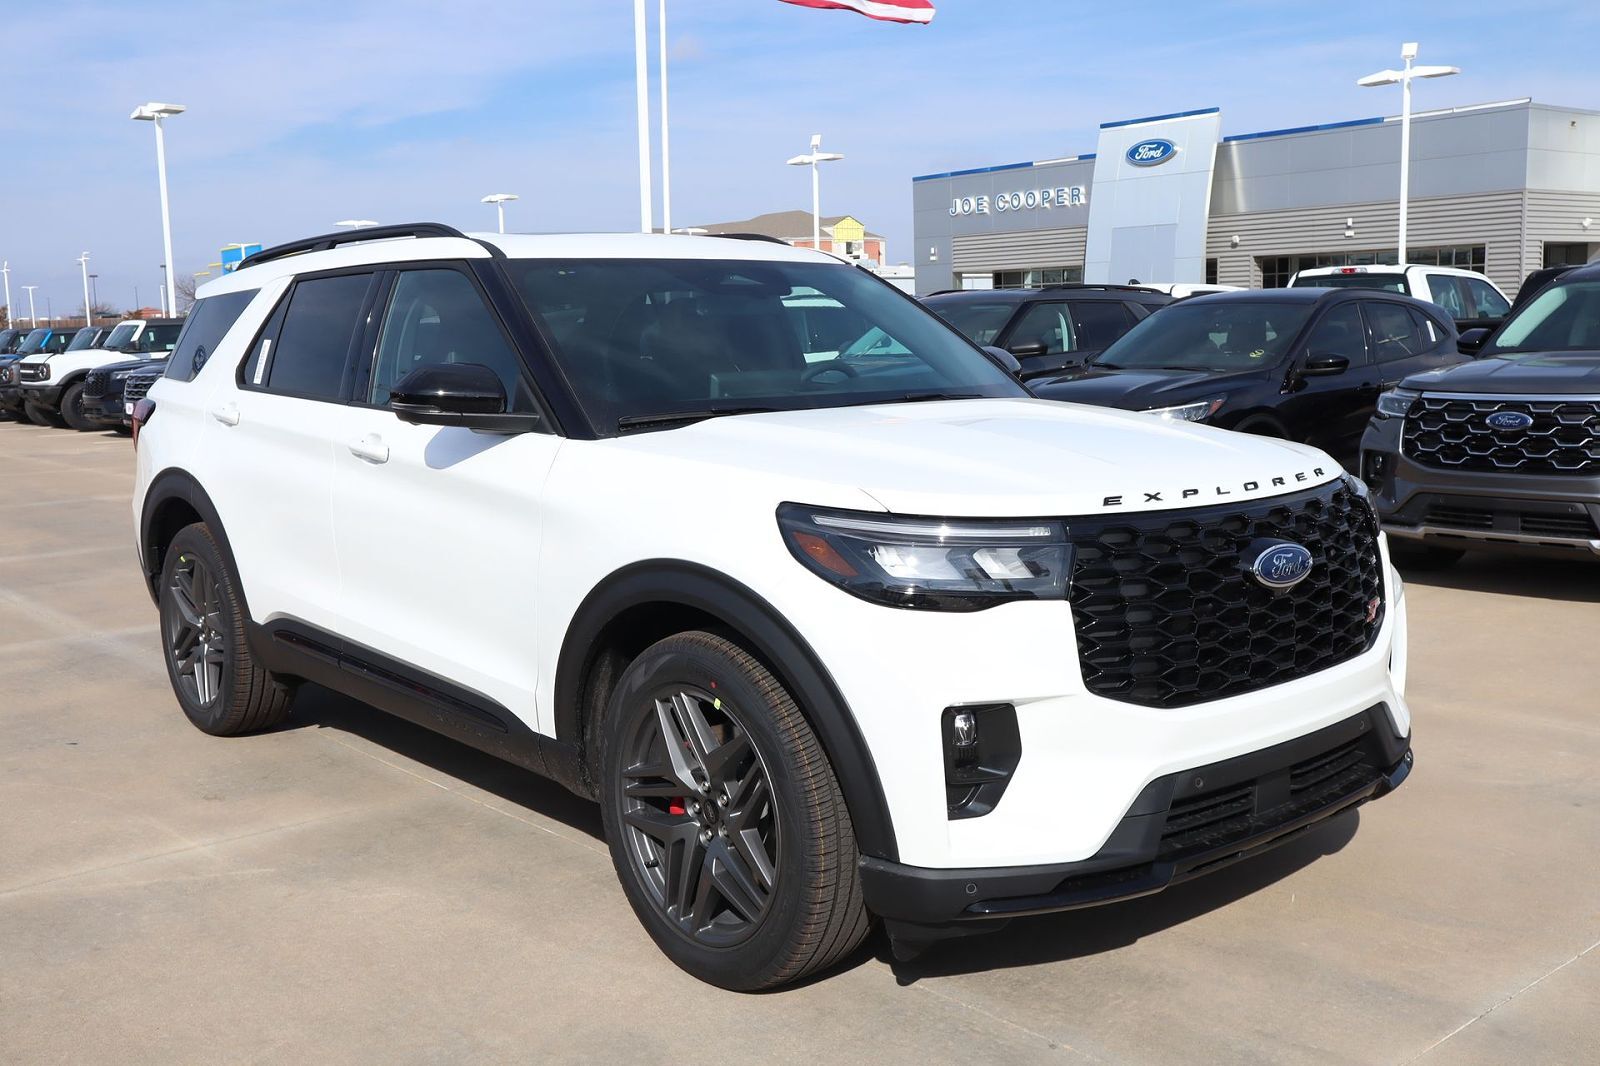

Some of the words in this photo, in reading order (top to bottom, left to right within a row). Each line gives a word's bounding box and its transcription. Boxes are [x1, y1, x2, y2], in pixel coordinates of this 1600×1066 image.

[1135, 143, 1165, 160] Ford
[949, 196, 987, 216] JOE
[995, 187, 1083, 211] COOPER
[1102, 467, 1325, 507] EXPLORER
[1271, 552, 1304, 578] Ford
